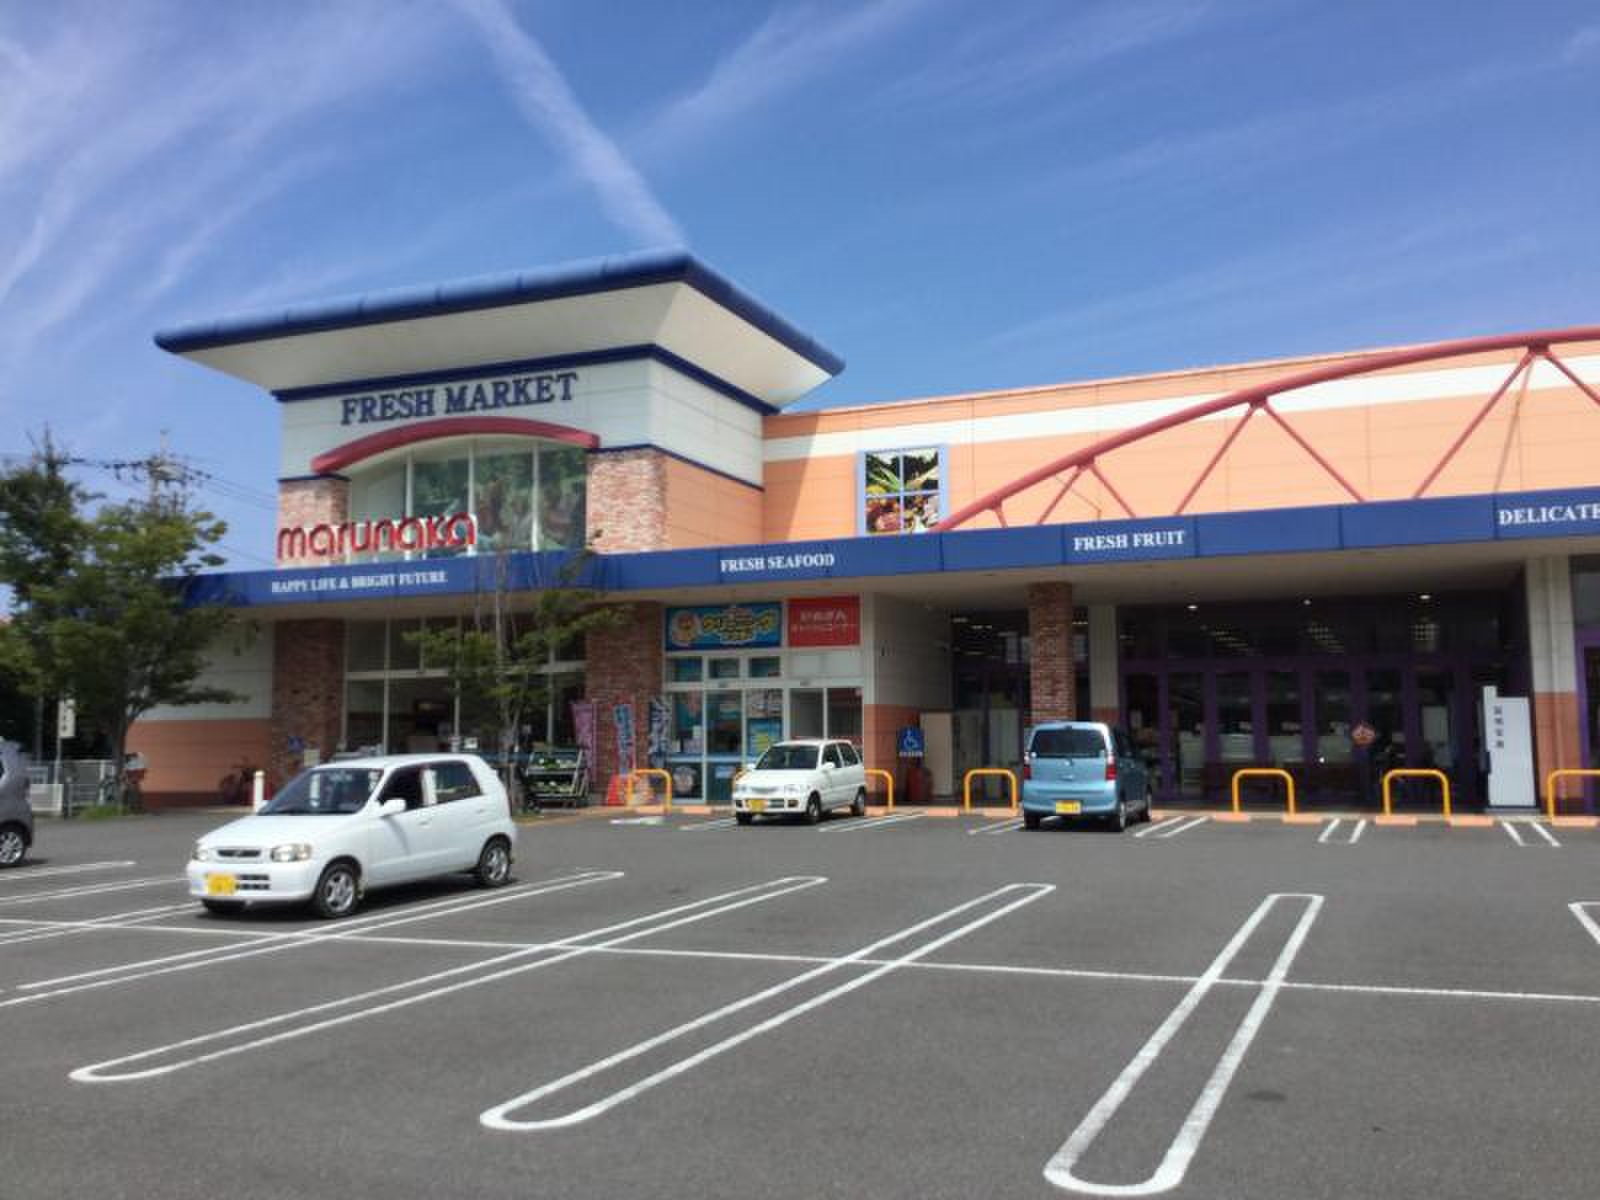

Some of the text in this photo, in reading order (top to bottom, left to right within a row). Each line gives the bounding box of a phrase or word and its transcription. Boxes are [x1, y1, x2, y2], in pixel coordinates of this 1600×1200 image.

[341, 372, 577, 425] FRESH MARKET
[277, 511, 476, 559] marunaka
[1073, 529, 1185, 551] FRESH FRUIT
[720, 553, 834, 572] FRESH SEAFOOD
[271, 579, 308, 593] HAPPY
[351, 573, 396, 589] BRIGHT
[399, 570, 448, 586] FUTURE
